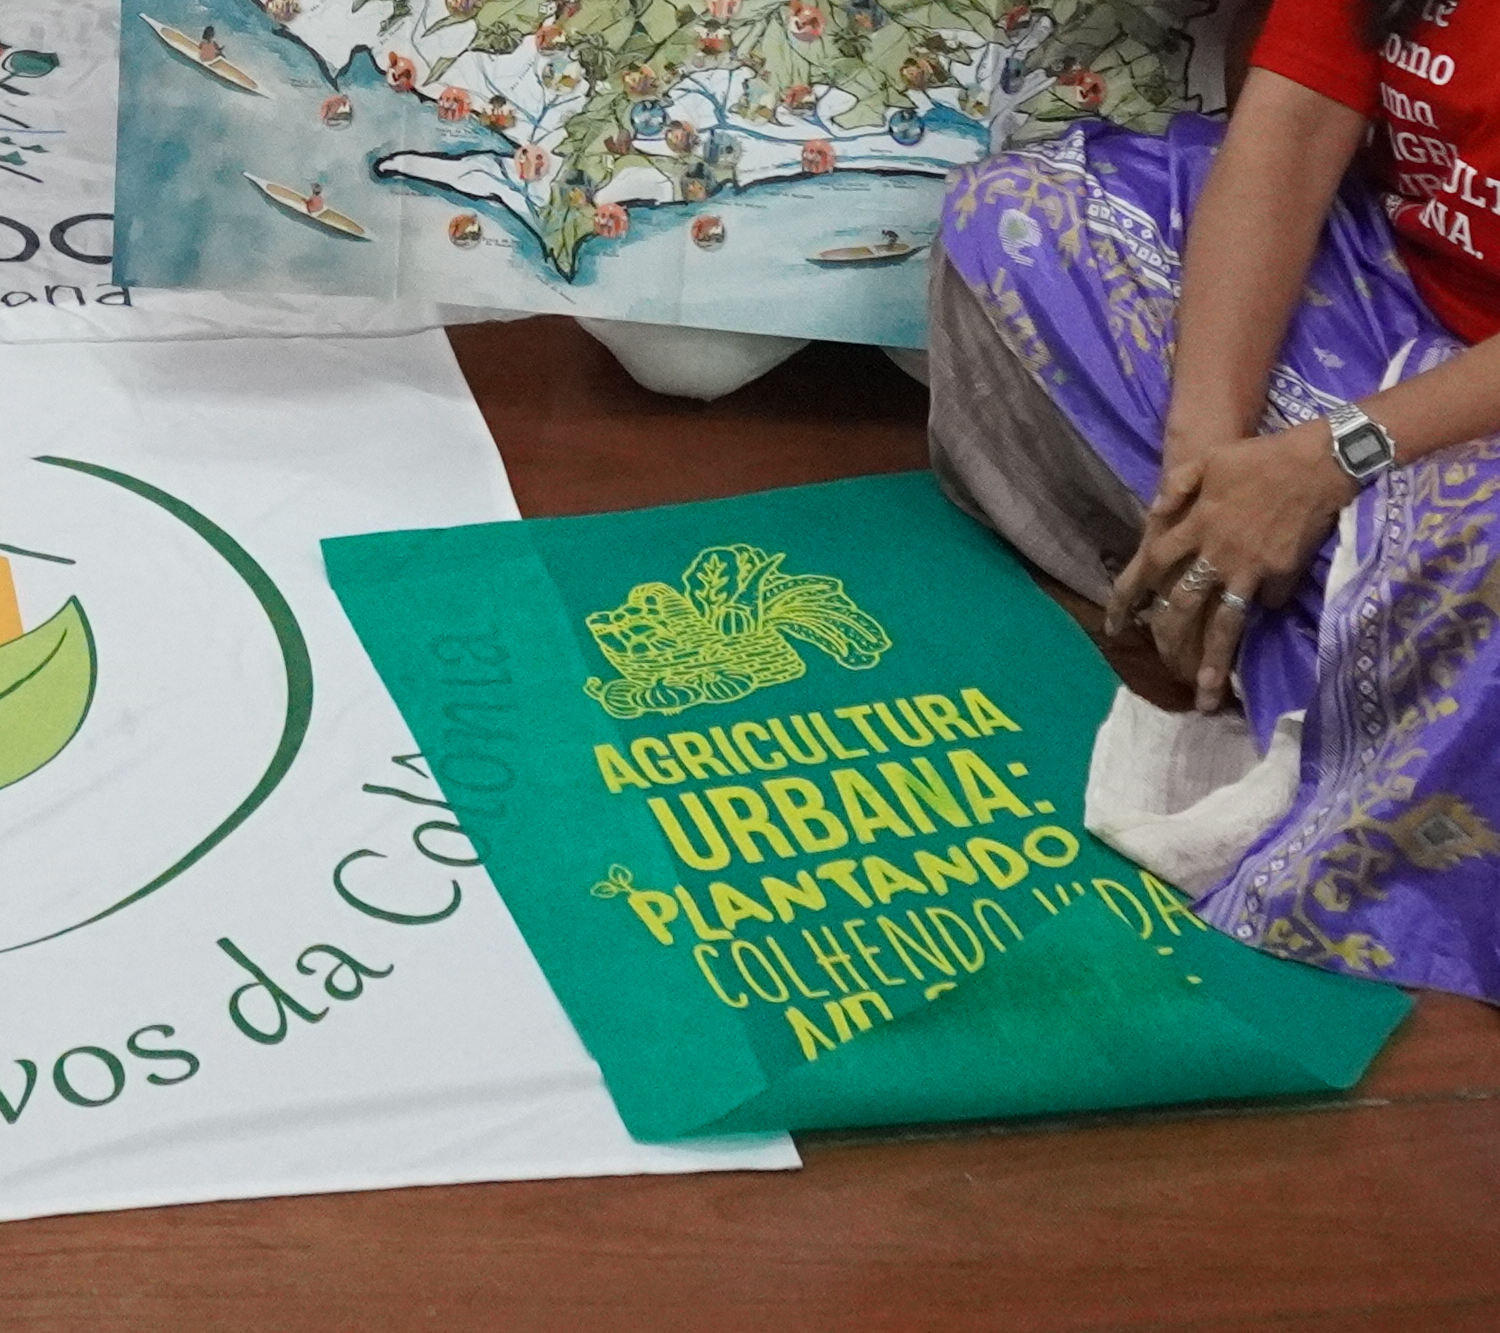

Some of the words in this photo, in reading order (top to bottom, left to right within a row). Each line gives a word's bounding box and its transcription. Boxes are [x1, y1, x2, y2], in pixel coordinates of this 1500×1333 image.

[594, 687, 1021, 794] AGRICULTURA
[646, 749, 1055, 872] URBANA:
[626, 825, 1080, 945] PLANTANDO
[226, 936, 394, 1045] da
